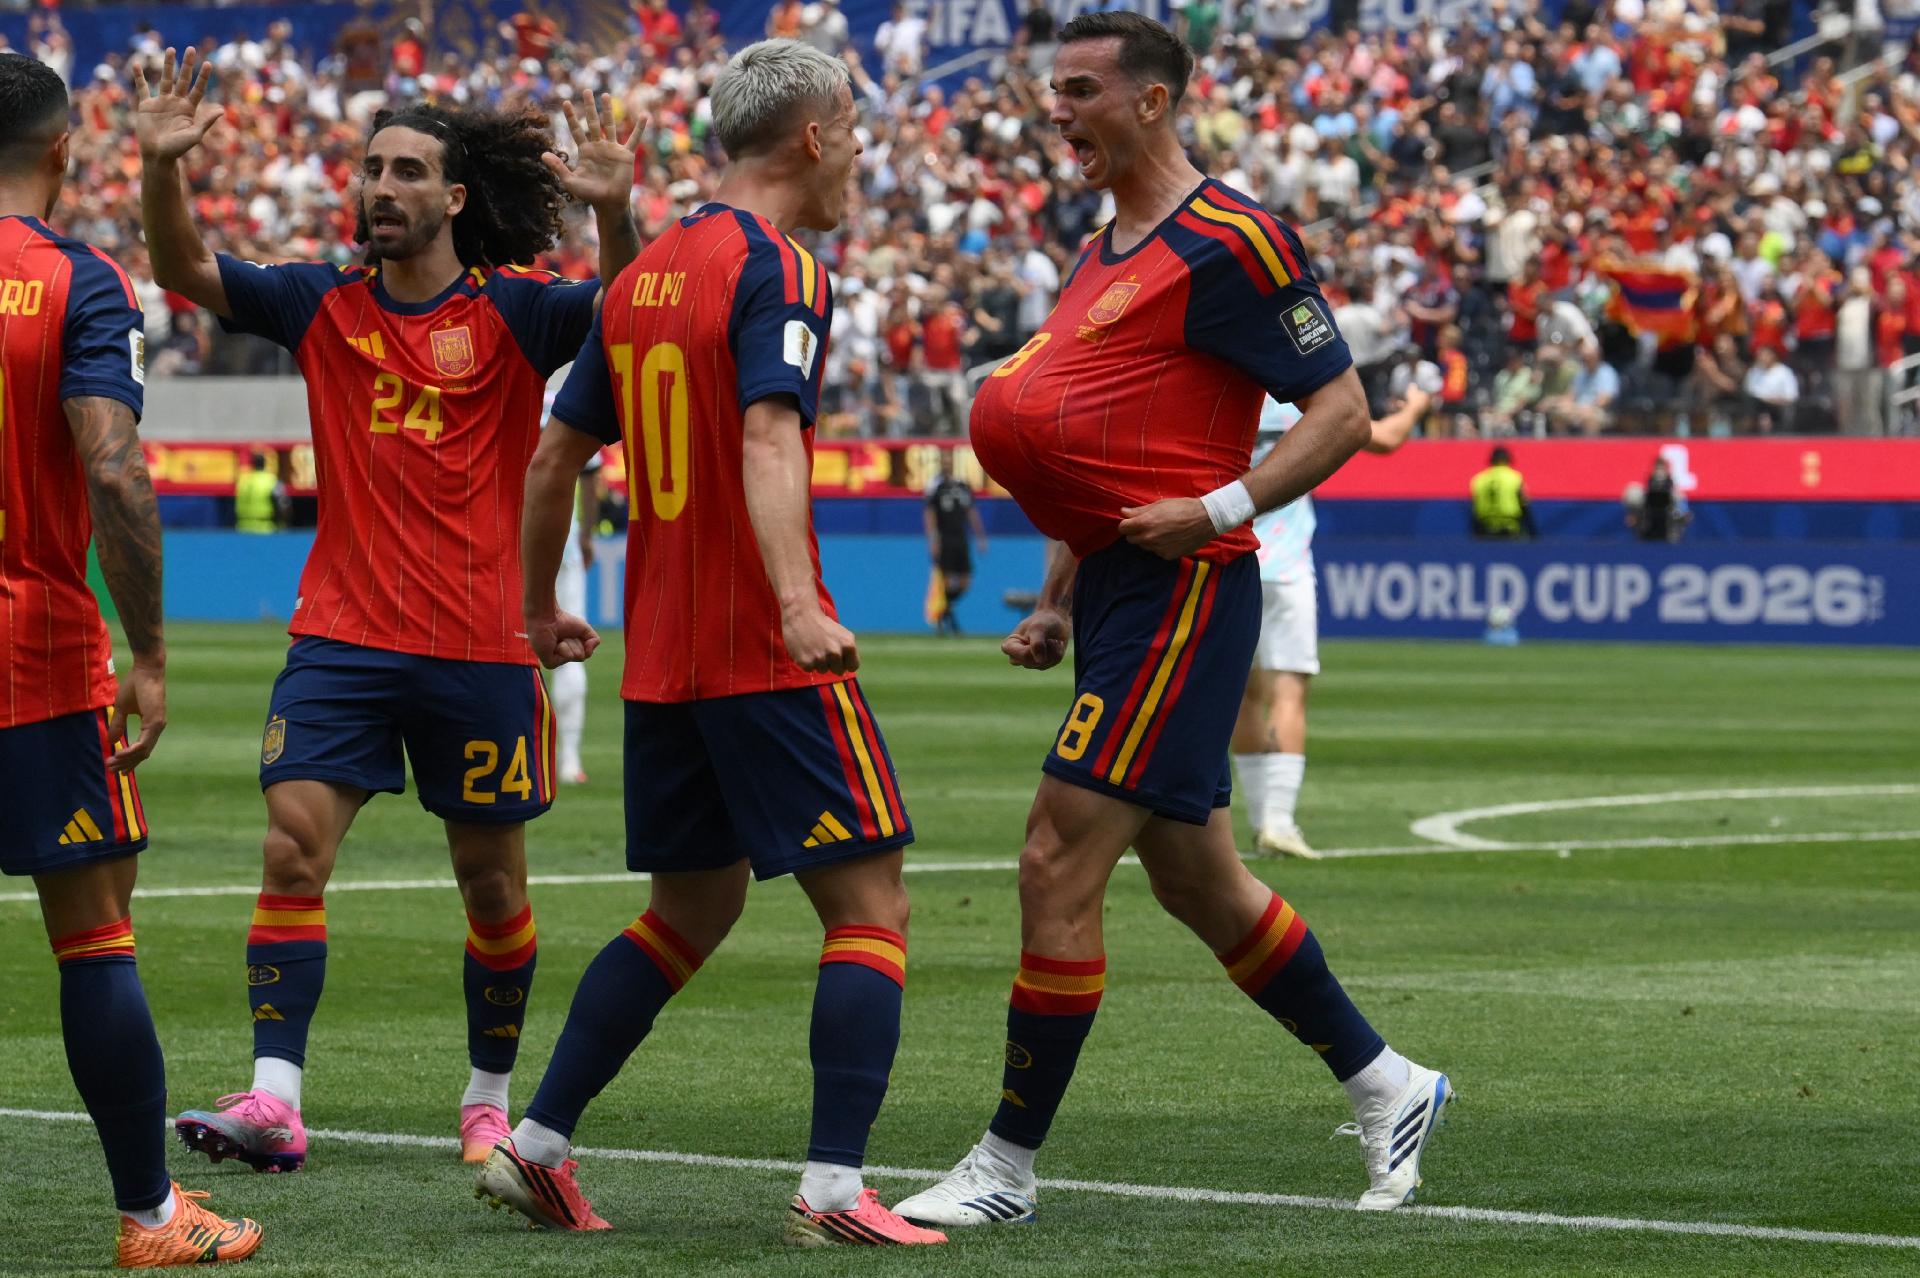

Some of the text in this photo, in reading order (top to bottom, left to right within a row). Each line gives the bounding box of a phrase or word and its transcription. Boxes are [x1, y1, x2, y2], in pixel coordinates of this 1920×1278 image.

[0, 279, 44, 316] RO
[632, 271, 687, 307] OLMO
[991, 332, 1052, 378] 8
[1298, 323, 1328, 346] EDUCATION
[369, 372, 443, 442] 24
[609, 341, 689, 522] 10
[1324, 562, 1527, 621] WORLD
[1534, 562, 1651, 623] CUP
[1657, 563, 1866, 627] 2026
[1057, 692, 1104, 761] 8
[463, 735, 532, 804] 24
